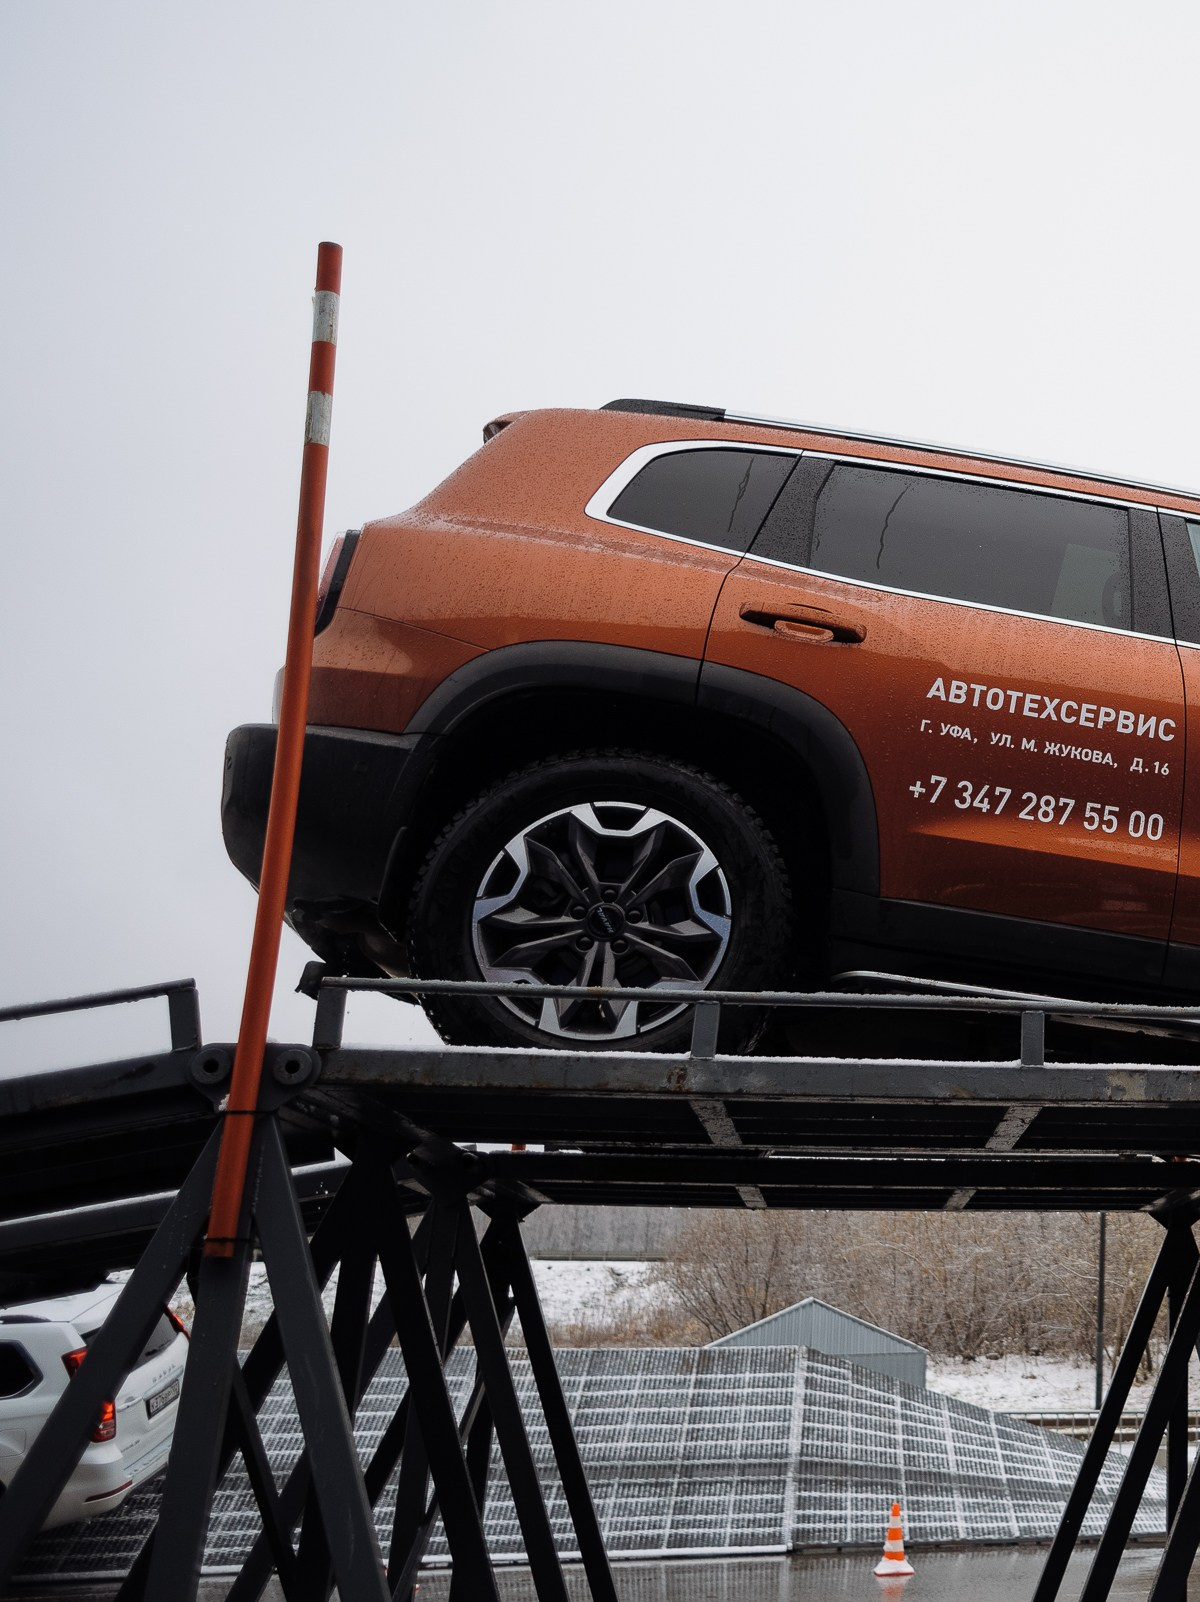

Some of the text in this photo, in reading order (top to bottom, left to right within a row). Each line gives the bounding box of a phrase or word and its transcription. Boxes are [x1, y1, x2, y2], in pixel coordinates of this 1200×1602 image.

[926, 677, 1176, 742] АВТОТЕХСЕРВИС
[919, 719, 933, 734] Г.
[940, 722, 978, 744] УФА,
[990, 732, 1015, 749] УЛ.
[1021, 737, 1038, 752] М.
[1043, 741, 1118, 769] ЖУКОВА,
[909, 774, 1164, 841] +7 347 287 55 00
